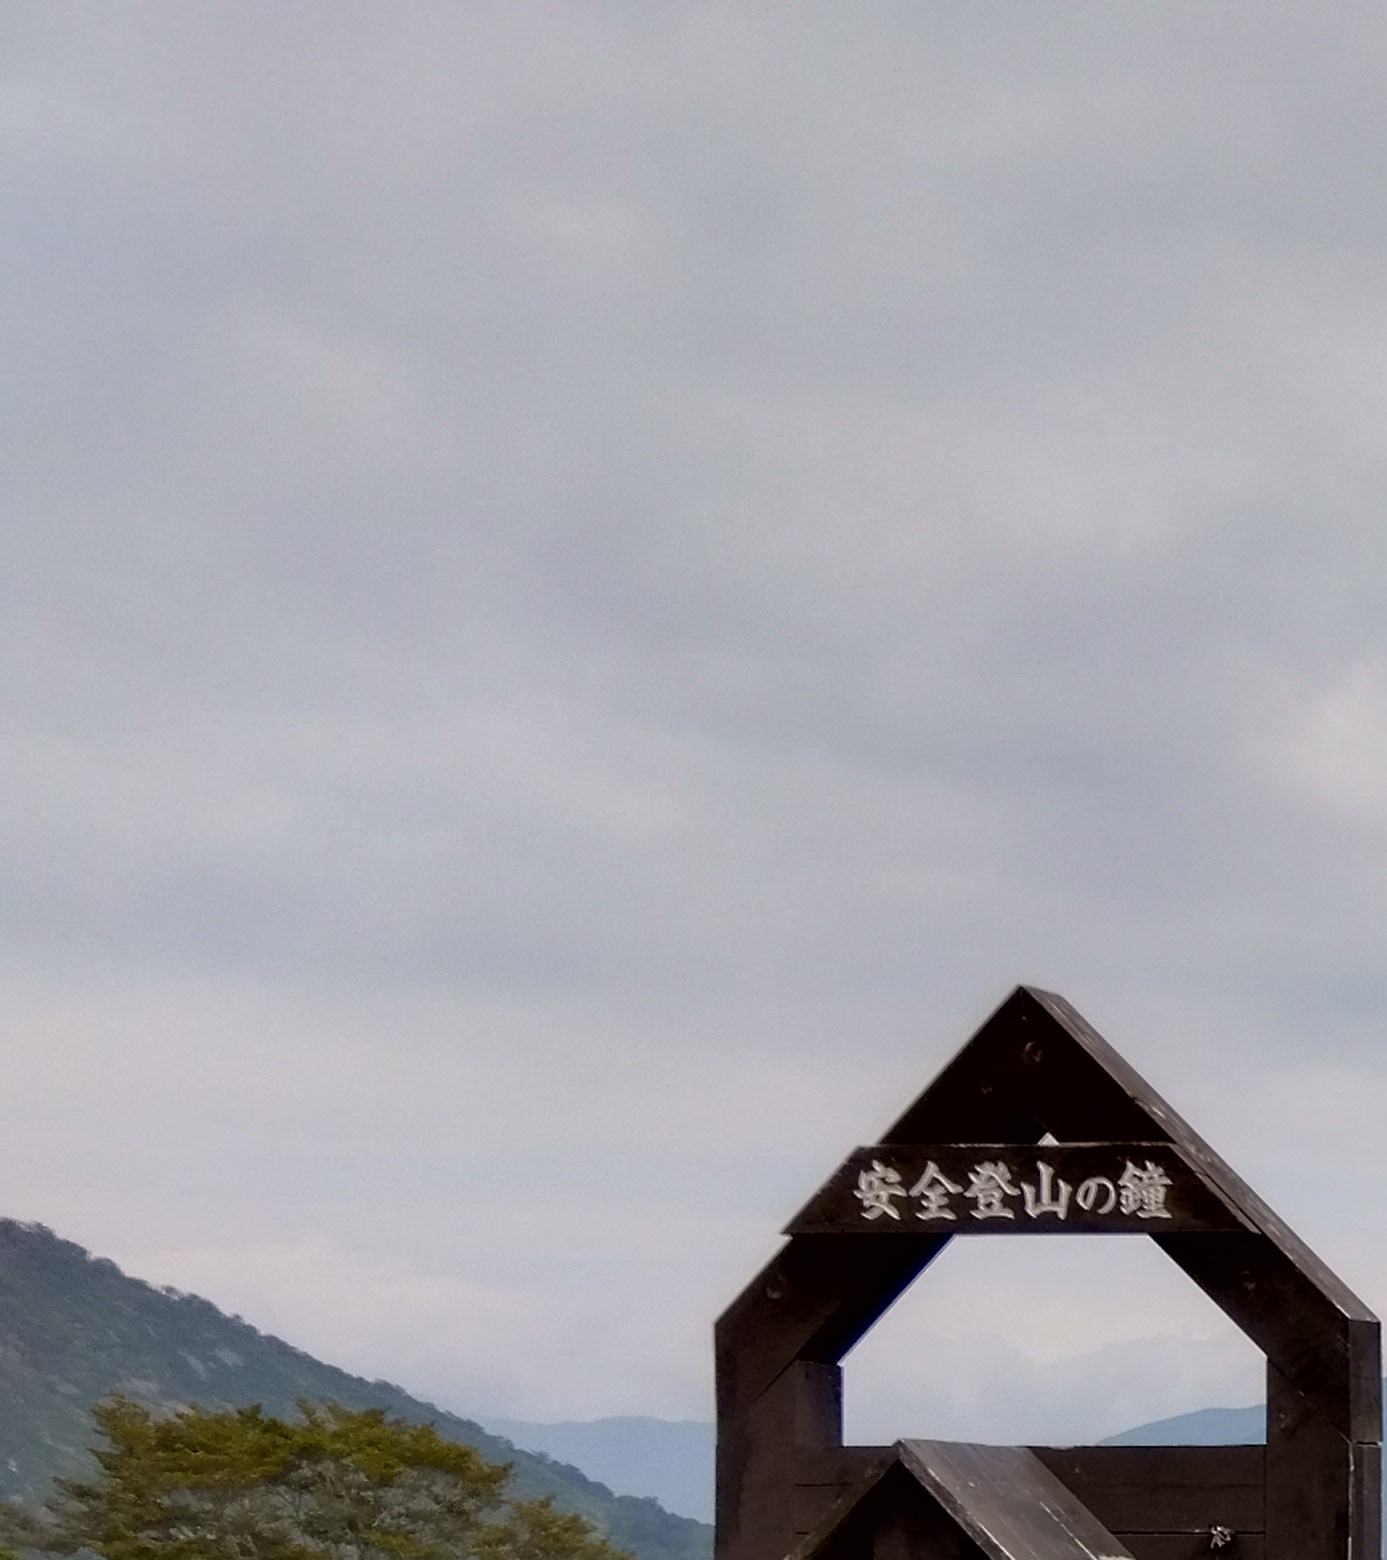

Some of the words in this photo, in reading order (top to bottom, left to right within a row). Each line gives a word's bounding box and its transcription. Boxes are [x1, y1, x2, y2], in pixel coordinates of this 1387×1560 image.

[853, 1159, 1174, 1221] 安全登山の鐘
